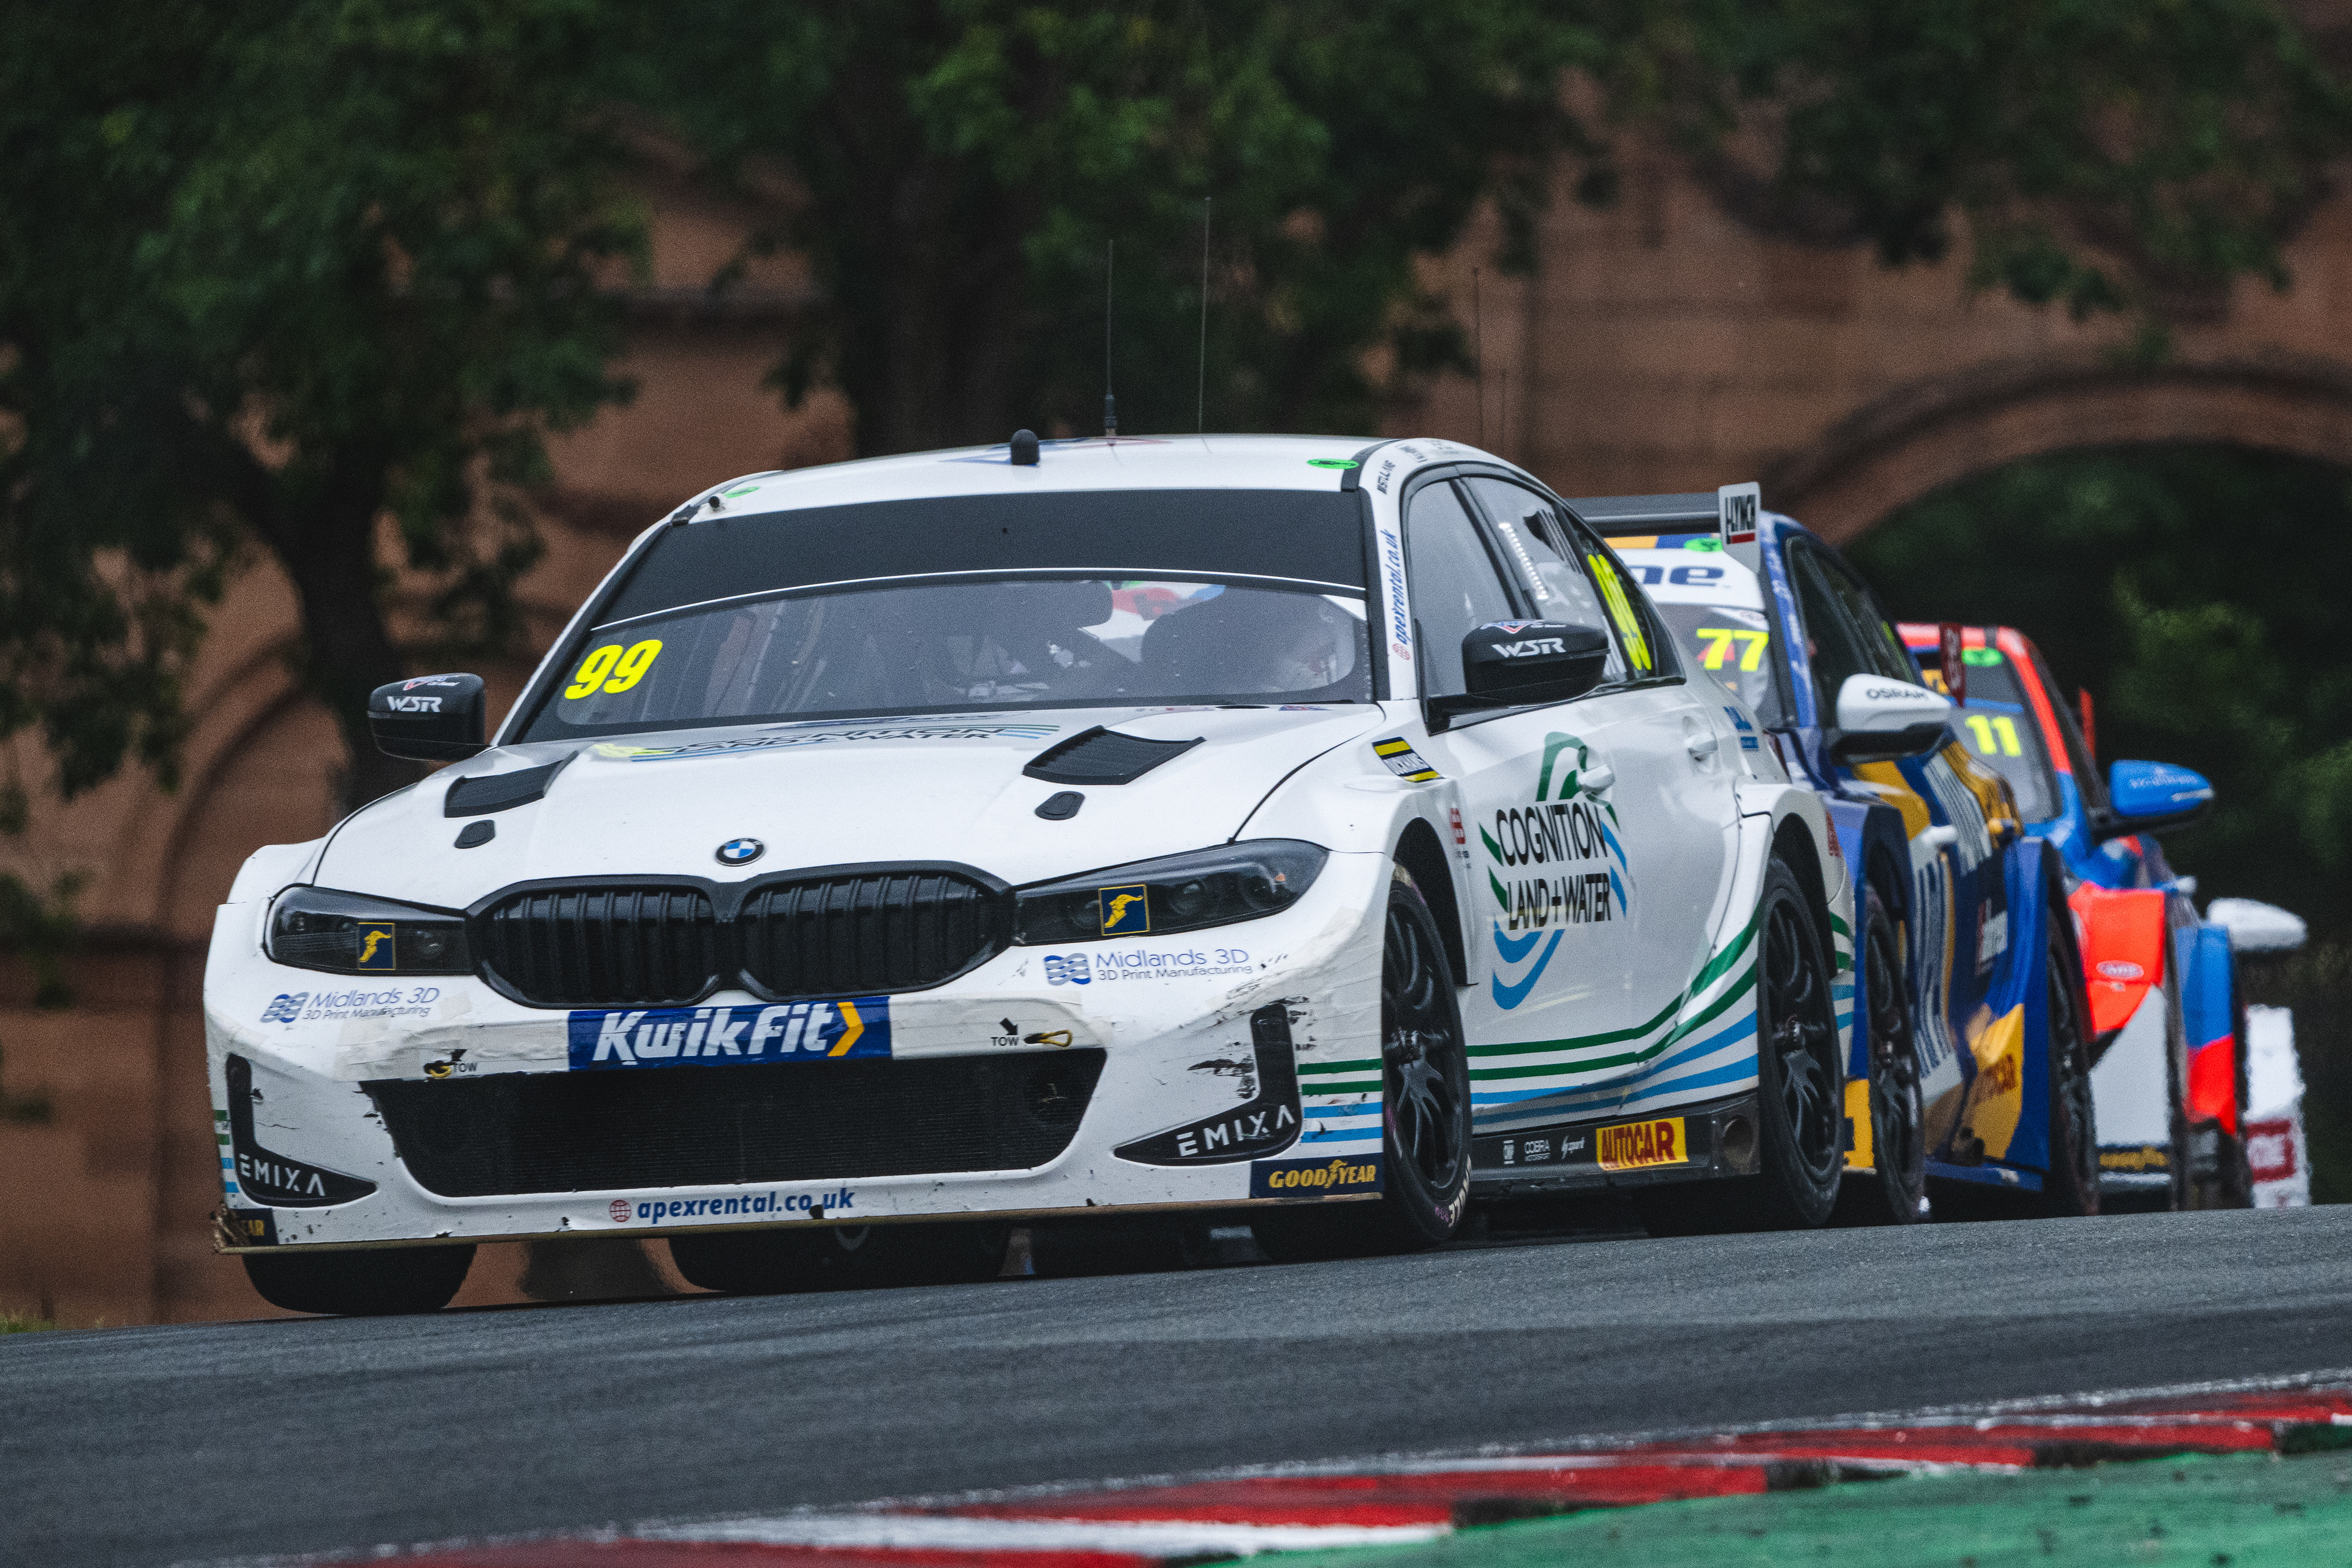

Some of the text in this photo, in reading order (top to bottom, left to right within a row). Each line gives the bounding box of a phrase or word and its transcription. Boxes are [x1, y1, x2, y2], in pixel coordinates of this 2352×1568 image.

[1491, 638, 1566, 658] WSR
[1697, 628, 1769, 672] 77
[565, 639, 663, 699] 99
[387, 696, 443, 712] WSR
[1964, 714, 2022, 757] 11
[1496, 802, 1608, 867] COGNITION
[1507, 878, 1550, 930] LAND
[1562, 873, 1611, 924] WATER
[1096, 949, 1250, 968] Midlands 3D
[1098, 965, 1253, 981] 3D Print Manufacturing
[307, 987, 440, 1008] Midlands 3D
[303, 1005, 432, 1020] 3D Print Manufacturing
[990, 1036, 1019, 1046] TOW
[452, 1063, 478, 1072] TOW
[1601, 1121, 1677, 1166] AUTOCAR
[1268, 1159, 1376, 1188] GOODYEAR
[637, 1188, 855, 1223] apexrental.couk
